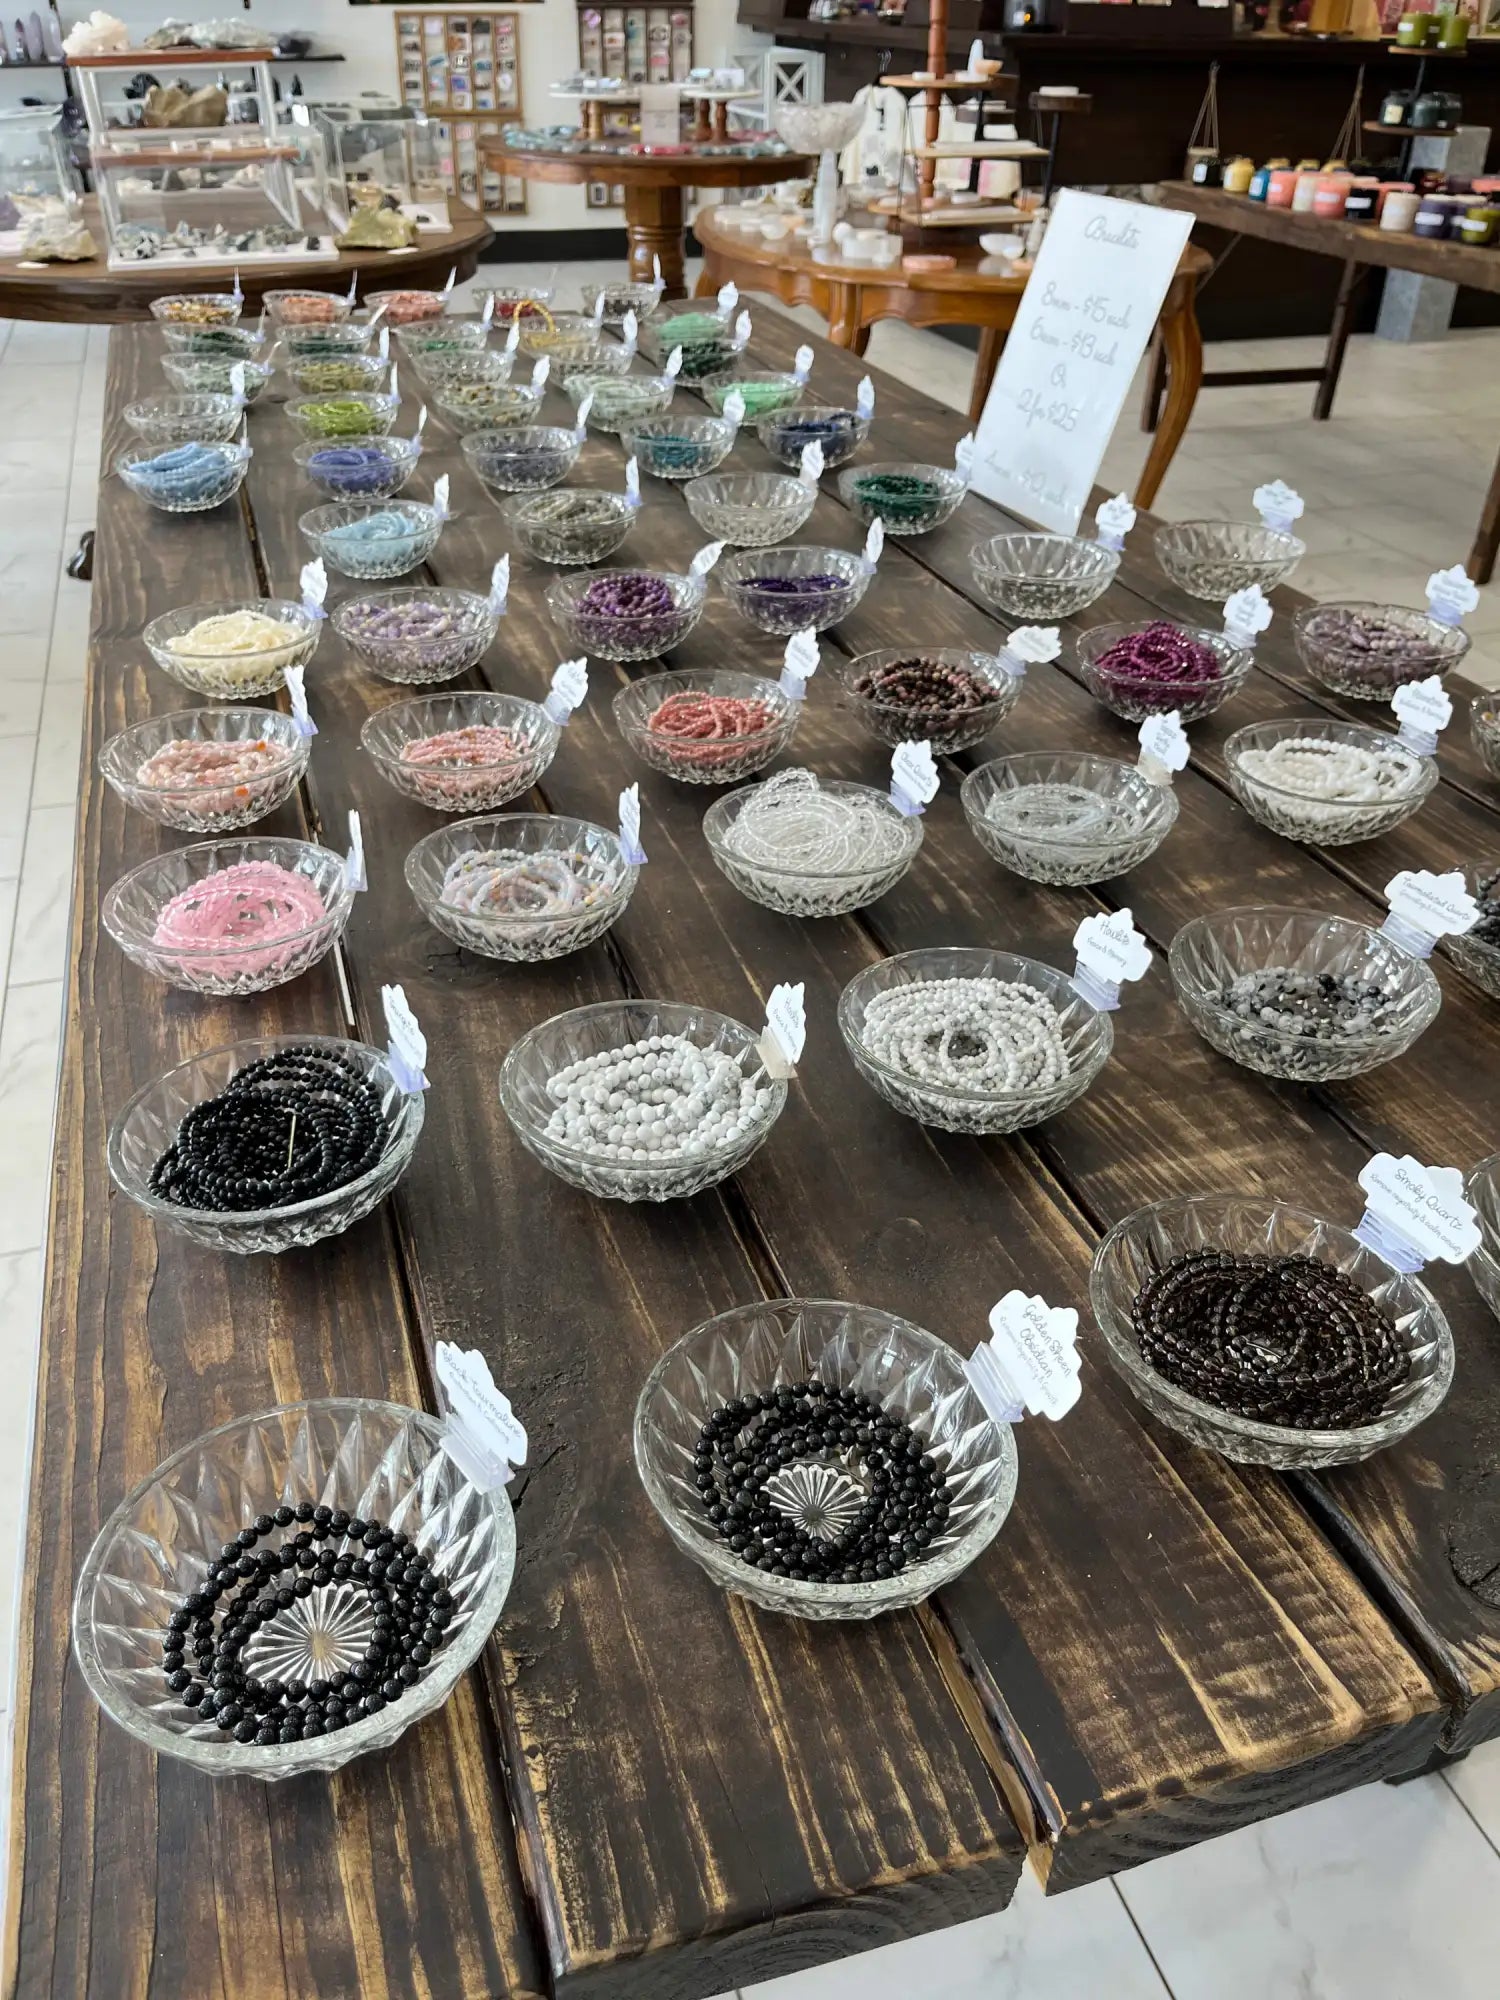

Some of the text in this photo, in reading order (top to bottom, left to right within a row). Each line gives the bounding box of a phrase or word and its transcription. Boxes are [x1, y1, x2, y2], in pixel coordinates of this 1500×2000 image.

[1084, 215, 1141, 249] Bracelets
[1047, 401, 1080, 432] $25
[1395, 1168, 1464, 1230] Smoky Quartz
[1020, 1328, 1053, 1378] Obsidian
[1022, 1303, 1072, 1377] Golden Sheen
[472, 1379, 522, 1438] Tourmaline
